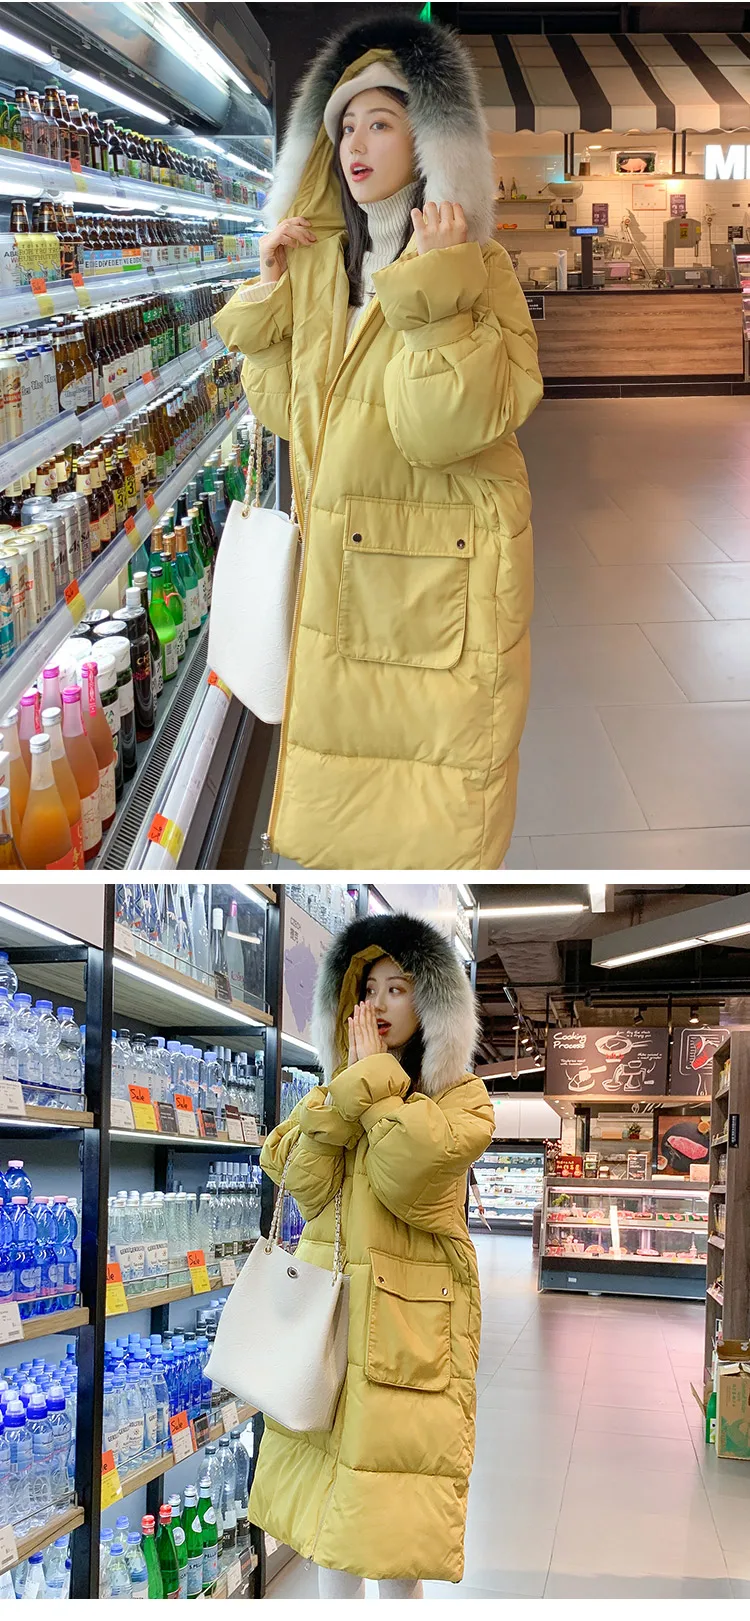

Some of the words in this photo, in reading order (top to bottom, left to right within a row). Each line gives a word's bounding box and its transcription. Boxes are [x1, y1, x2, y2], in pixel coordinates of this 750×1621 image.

[704, 144, 750, 180] M
[553, 1031, 587, 1044] Cooking
[553, 1041, 586, 1049] Process
[129, 1089, 145, 1102] Sale
[175, 1097, 188, 1109] Sale
[187, 1254, 200, 1266] Sale
[170, 1417, 183, 1433] Sale
